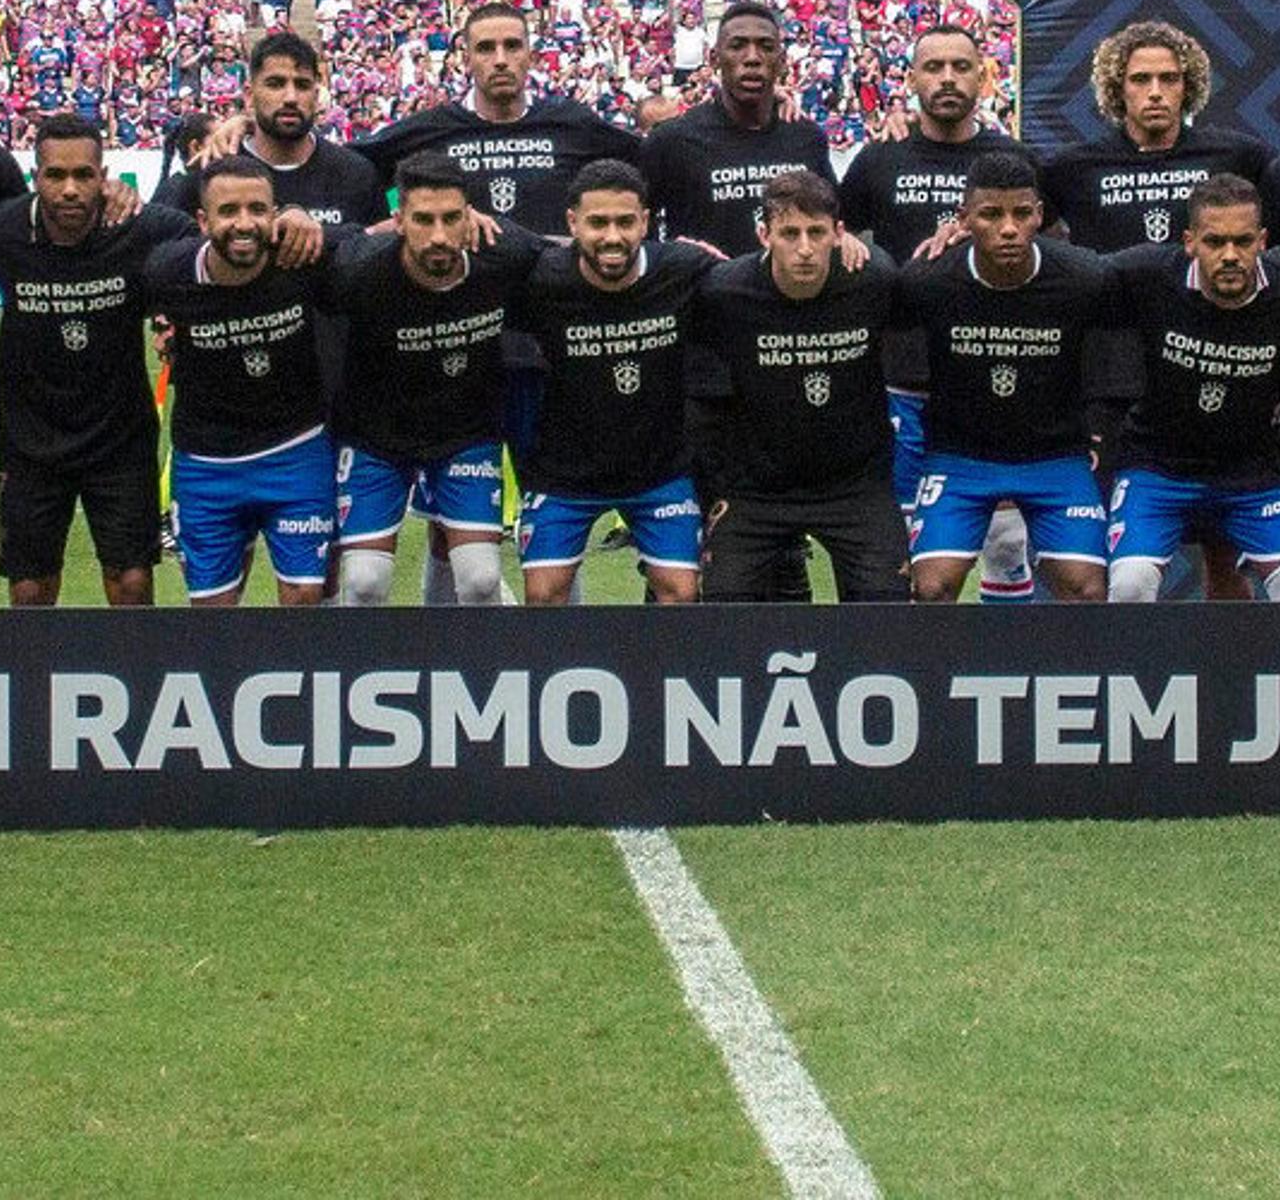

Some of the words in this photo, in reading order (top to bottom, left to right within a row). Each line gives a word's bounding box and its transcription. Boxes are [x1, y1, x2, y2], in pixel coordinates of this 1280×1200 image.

[448, 141, 481, 157] COM
[483, 139, 552, 154] RACISMO
[482, 156, 514, 169] TEM
[712, 167, 745, 183] COM
[896, 175, 931, 188] COM
[935, 175, 967, 188] RAC
[1101, 175, 1135, 190] COM
[712, 184, 744, 202] NÃO
[895, 189, 928, 204] NÃO
[931, 191, 964, 205] TEM
[1101, 189, 1133, 207] NÃO
[1136, 187, 1168, 201] TEM
[16, 283, 49, 297] COM
[52, 277, 125, 296] RACISMO
[51, 300, 84, 312] TEM
[190, 323, 226, 337] COM
[228, 305, 302, 333] RACISMO
[397, 326, 432, 339] COM
[435, 308, 504, 336] RACISMO
[566, 325, 602, 340] COM
[605, 316, 676, 338] RACISMO
[229, 332, 264, 345] TEM
[434, 335, 466, 348] TEM
[757, 335, 794, 349] COM
[796, 328, 869, 348] RACISMO
[951, 326, 986, 339] COM
[989, 326, 1061, 342] RACISMO
[603, 340, 637, 354] TEM
[985, 343, 1017, 356] TEM
[1165, 331, 1201, 354] COM
[1203, 342, 1276, 361] RACISMO
[795, 350, 828, 365] TEM
[1198, 359, 1231, 375] TEM
[50, 667, 630, 771] RACISMO
[663, 651, 919, 767] NÃO
[949, 674, 1198, 765] TEM
